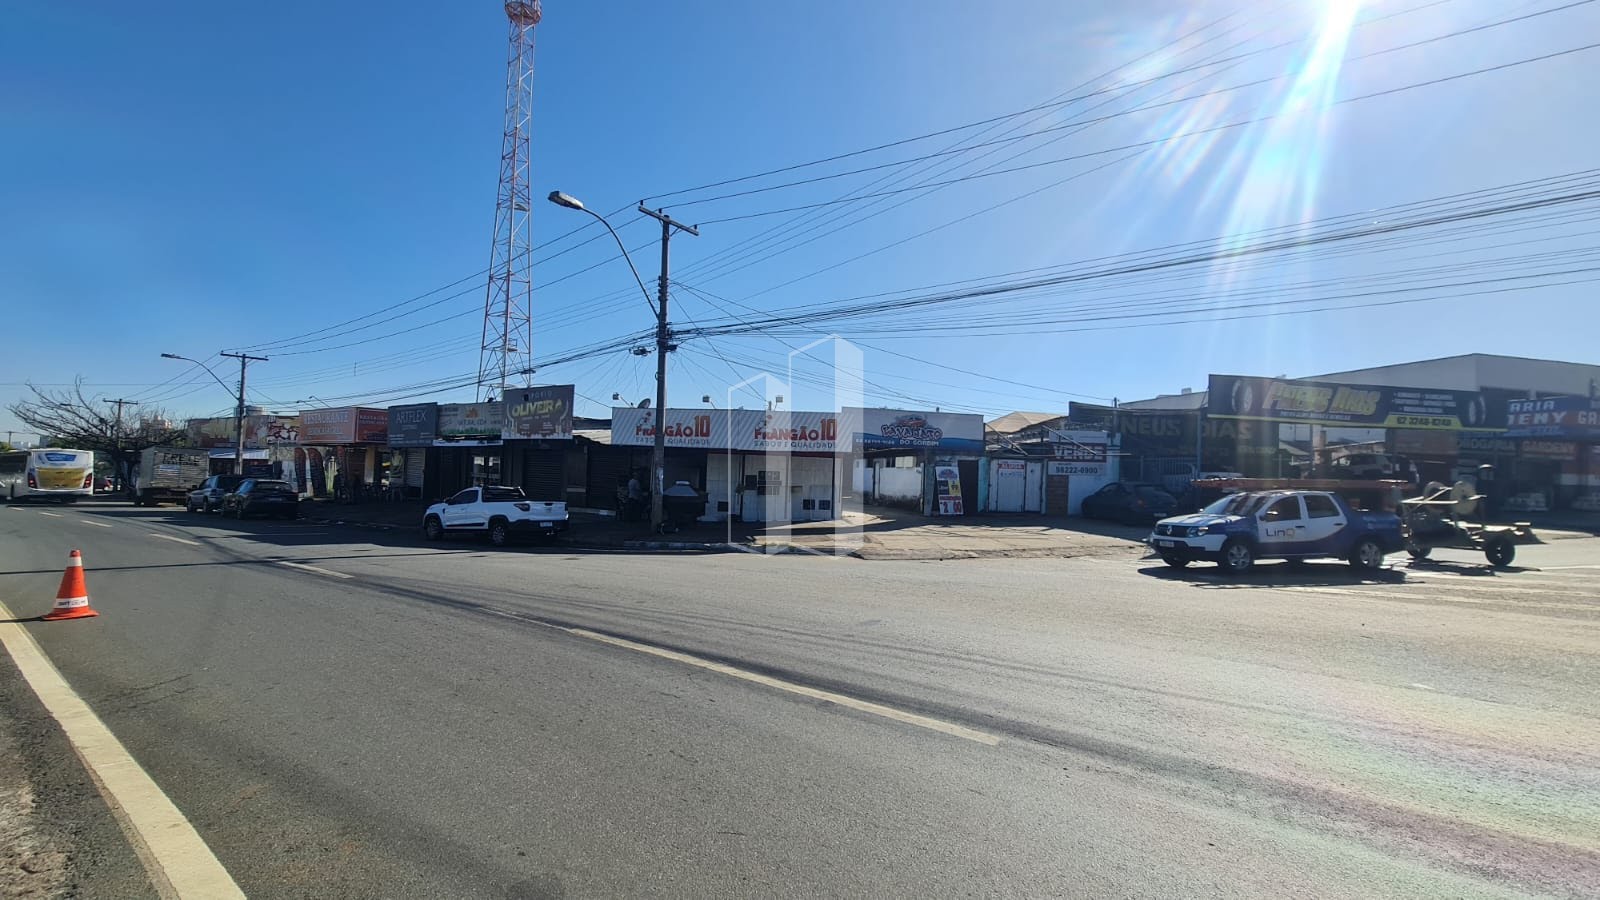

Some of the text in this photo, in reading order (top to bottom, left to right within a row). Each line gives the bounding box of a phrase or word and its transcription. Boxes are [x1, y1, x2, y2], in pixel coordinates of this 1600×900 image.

[511, 399, 563, 417] OLIVEIRA
[1510, 400, 1555, 412] ARIA
[395, 409, 427, 424] ARTFLEX
[1577, 411, 1600, 425] GA
[636, 416, 711, 437] FRAGÃO 10
[754, 418, 837, 441] FRANGÃO 10
[1053, 445, 1105, 460] VENDE
